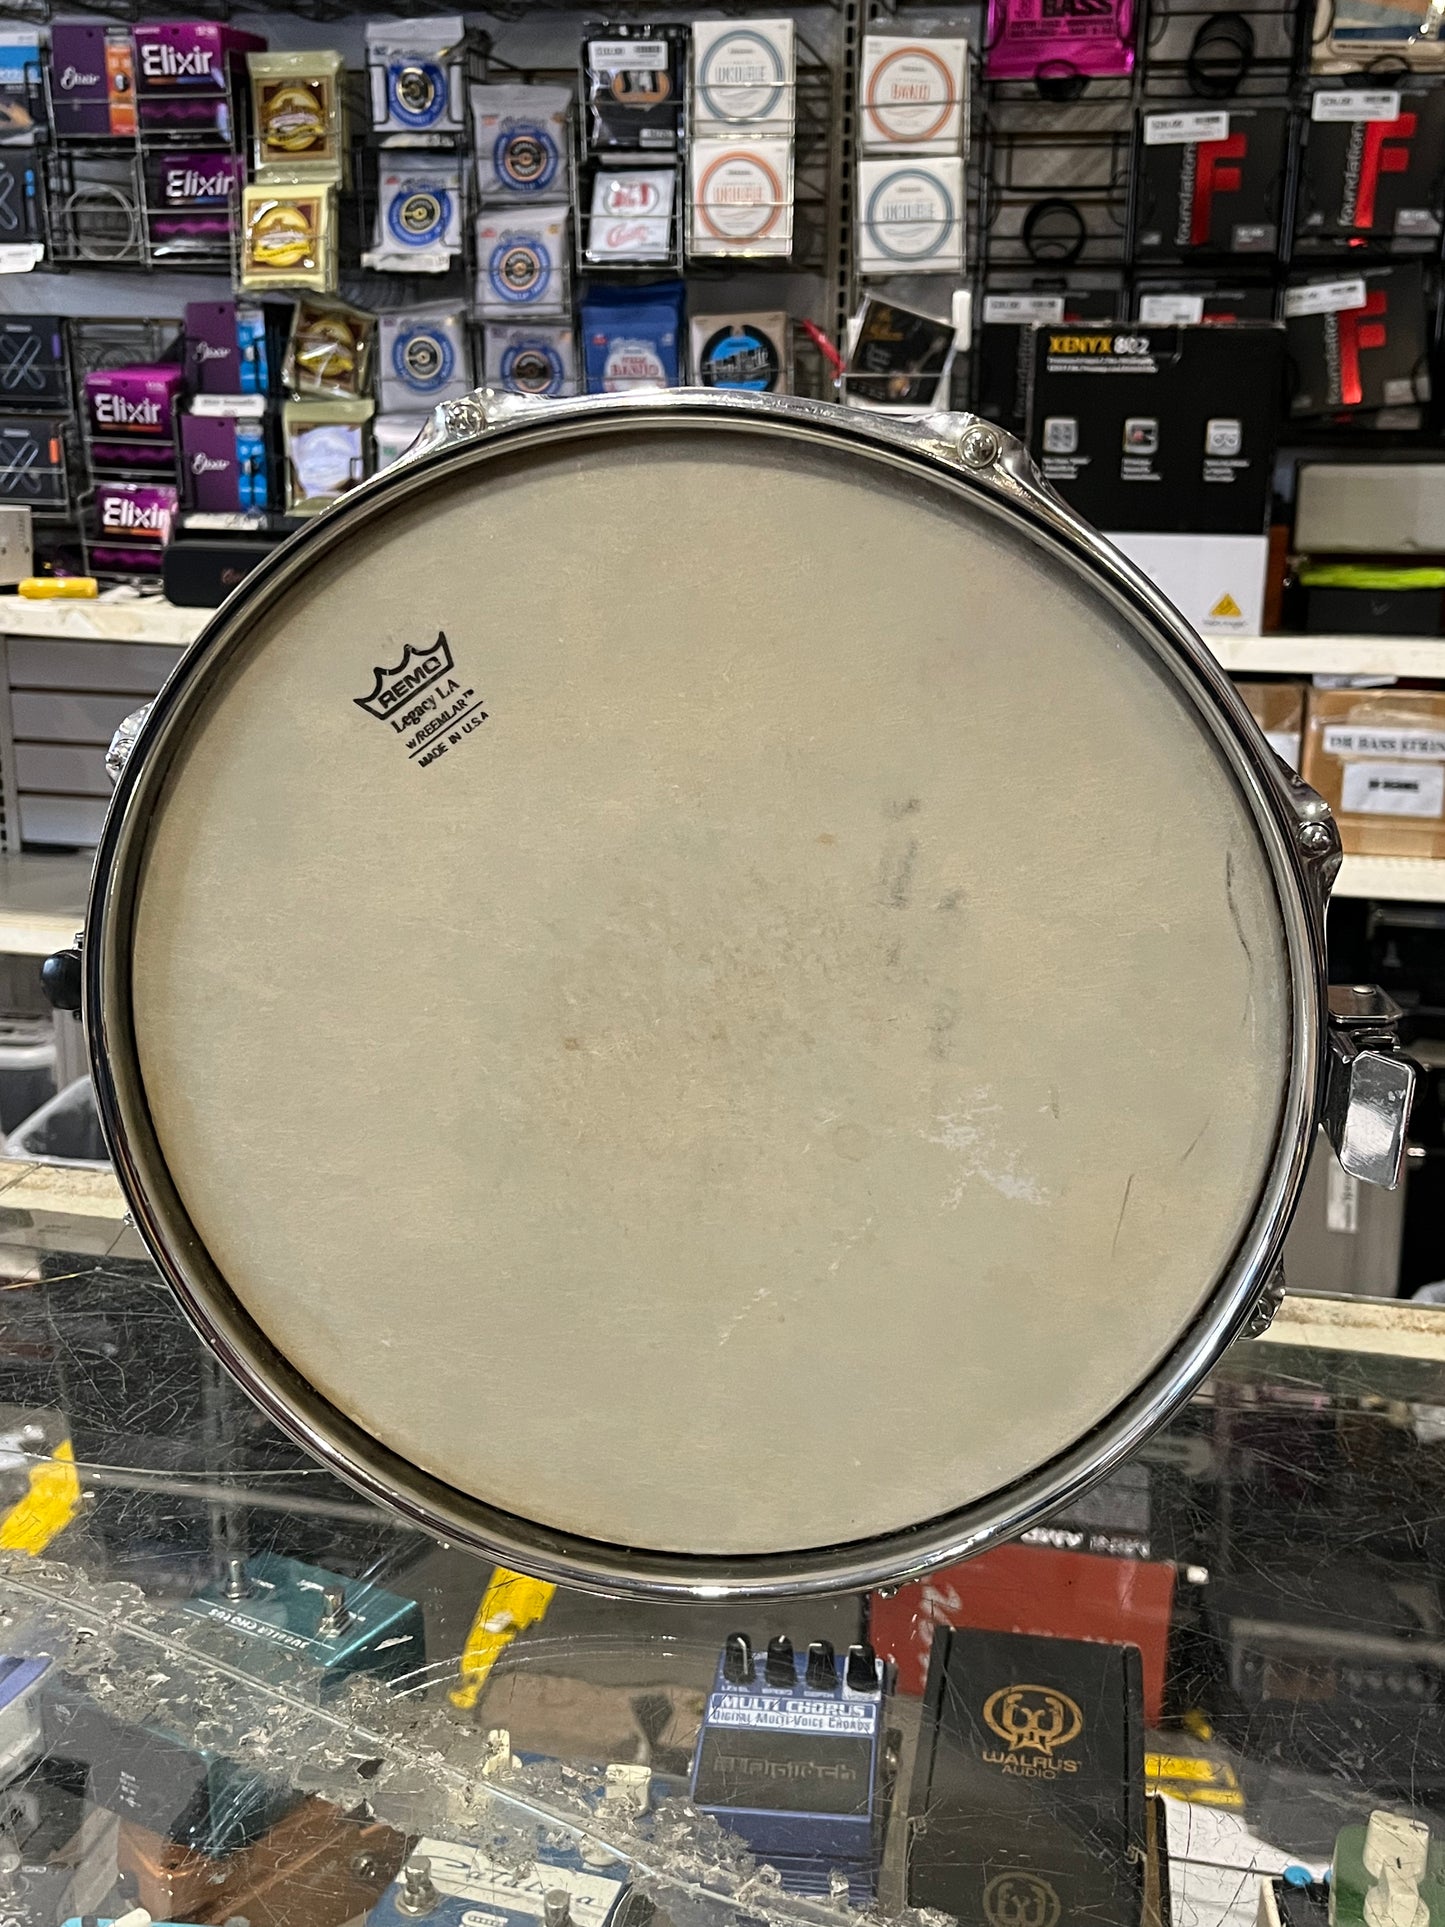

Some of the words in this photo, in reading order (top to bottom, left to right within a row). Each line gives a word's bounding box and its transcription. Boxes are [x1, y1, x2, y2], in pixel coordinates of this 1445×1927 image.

[141, 44, 213, 77] Elixir
[166, 169, 235, 198] Elixir
[1049, 335, 1113, 353] XENYX
[94, 393, 162, 424] Elixir
[103, 496, 176, 528] Elixir
[378, 656, 442, 709] REMO
[391, 695, 438, 733] Legacy
[435, 679, 460, 699] LA
[418, 742, 449, 768] MADE
[448, 732, 462, 744] IN
[721, 1695, 780, 1711] MULTI
[786, 1700, 866, 1717] CHORUS
[982, 1750, 1078, 1773] WALRUS
[1001, 1764, 1057, 1780] AUDIO
